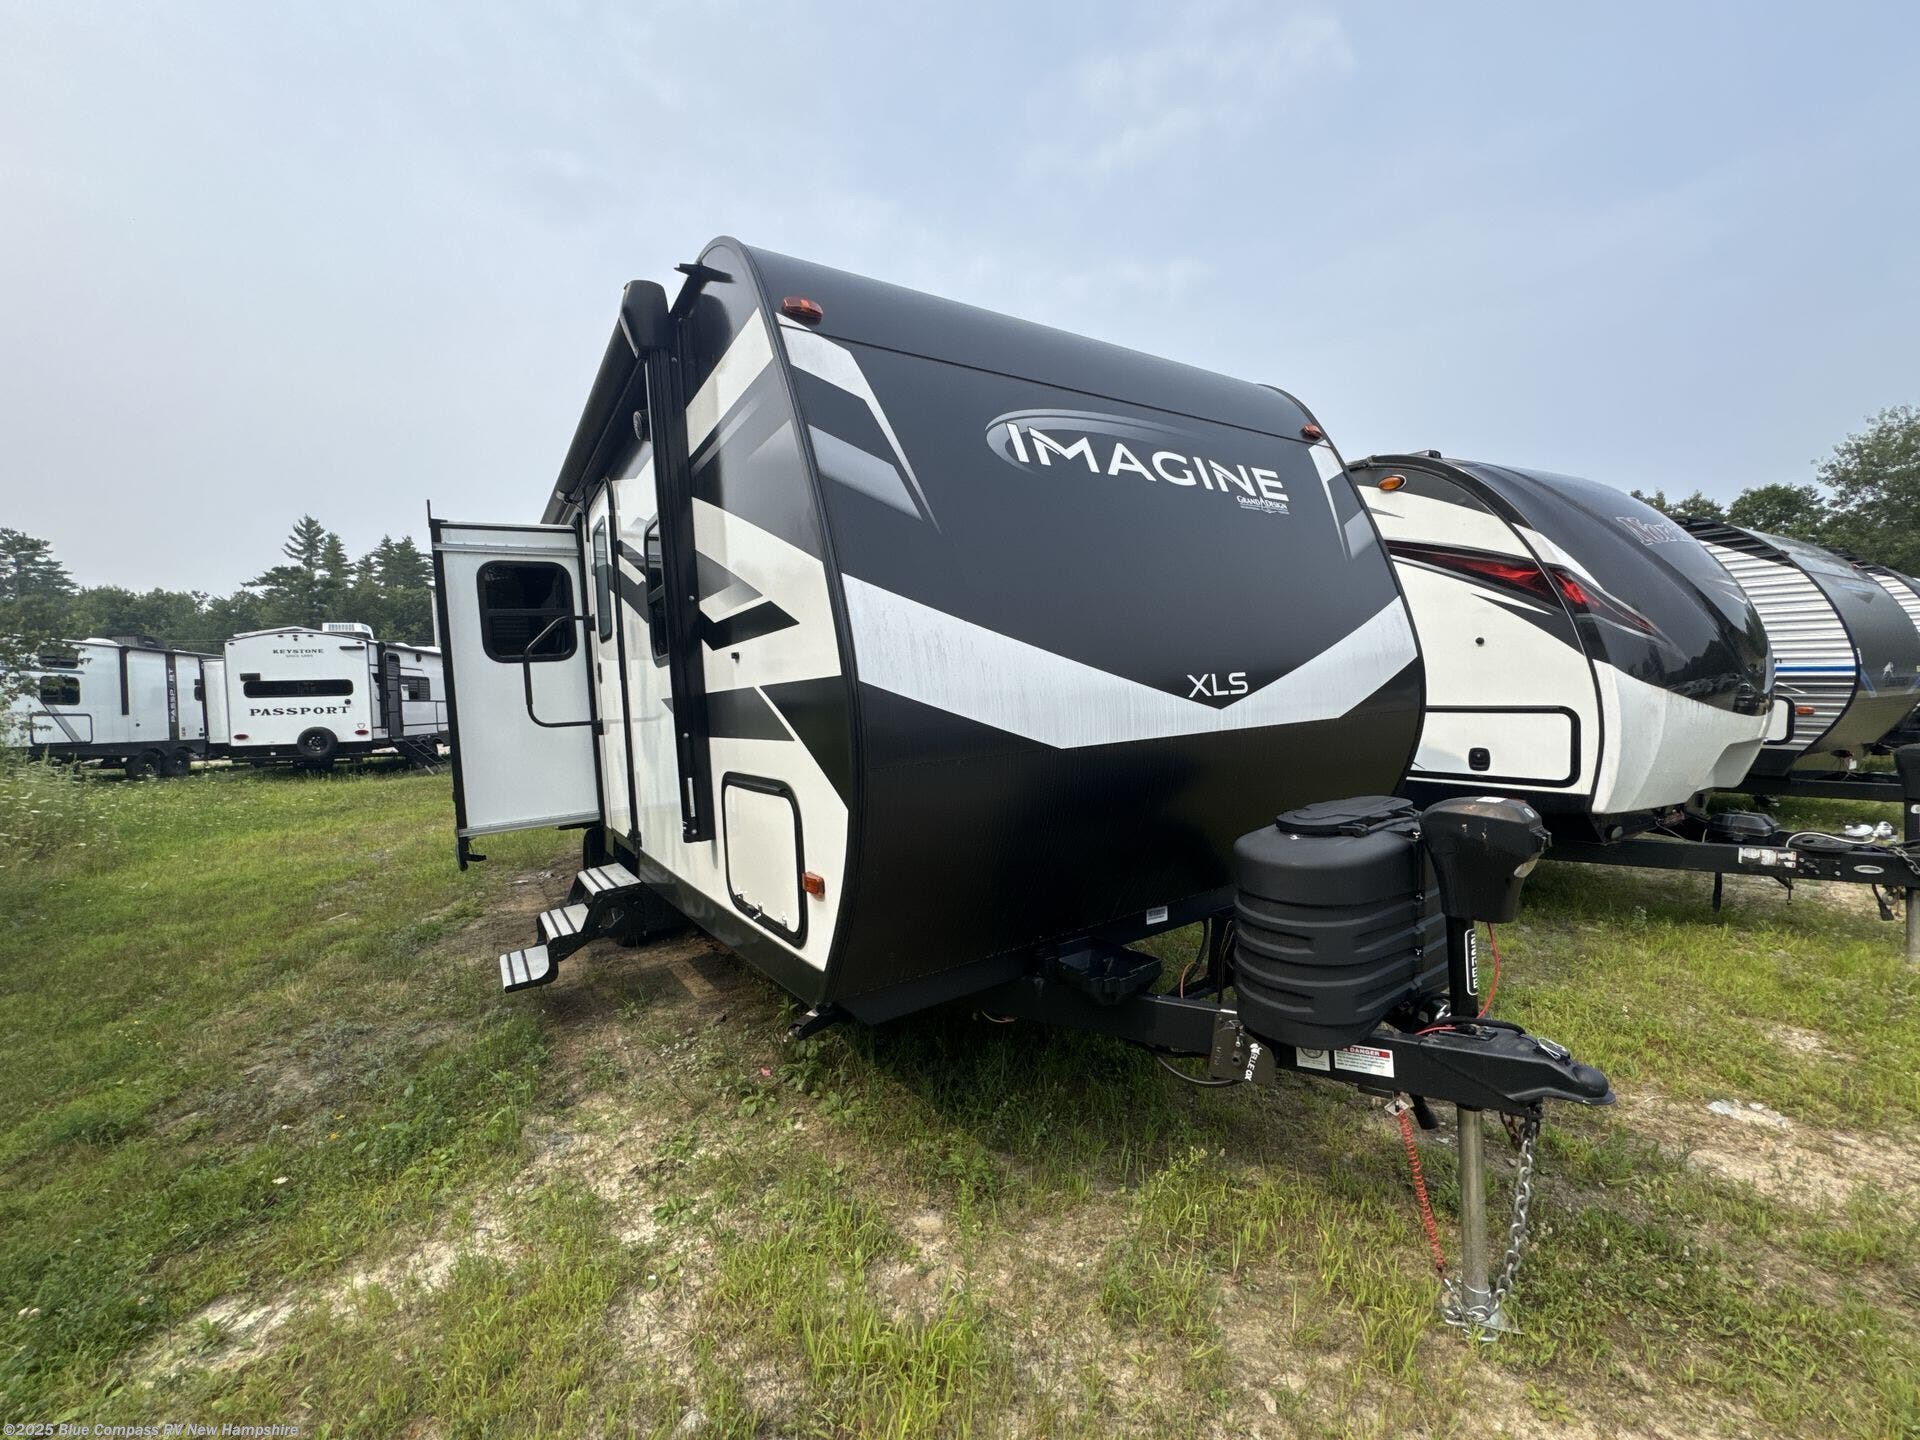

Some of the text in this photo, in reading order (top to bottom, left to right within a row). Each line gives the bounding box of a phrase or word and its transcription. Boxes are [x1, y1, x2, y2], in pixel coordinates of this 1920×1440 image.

[1006, 422, 1290, 502] IMAGINE
[1186, 671, 1249, 699] XLS
[249, 705, 351, 717] PASSPORT
[1349, 1046, 1381, 1057] DANGER
